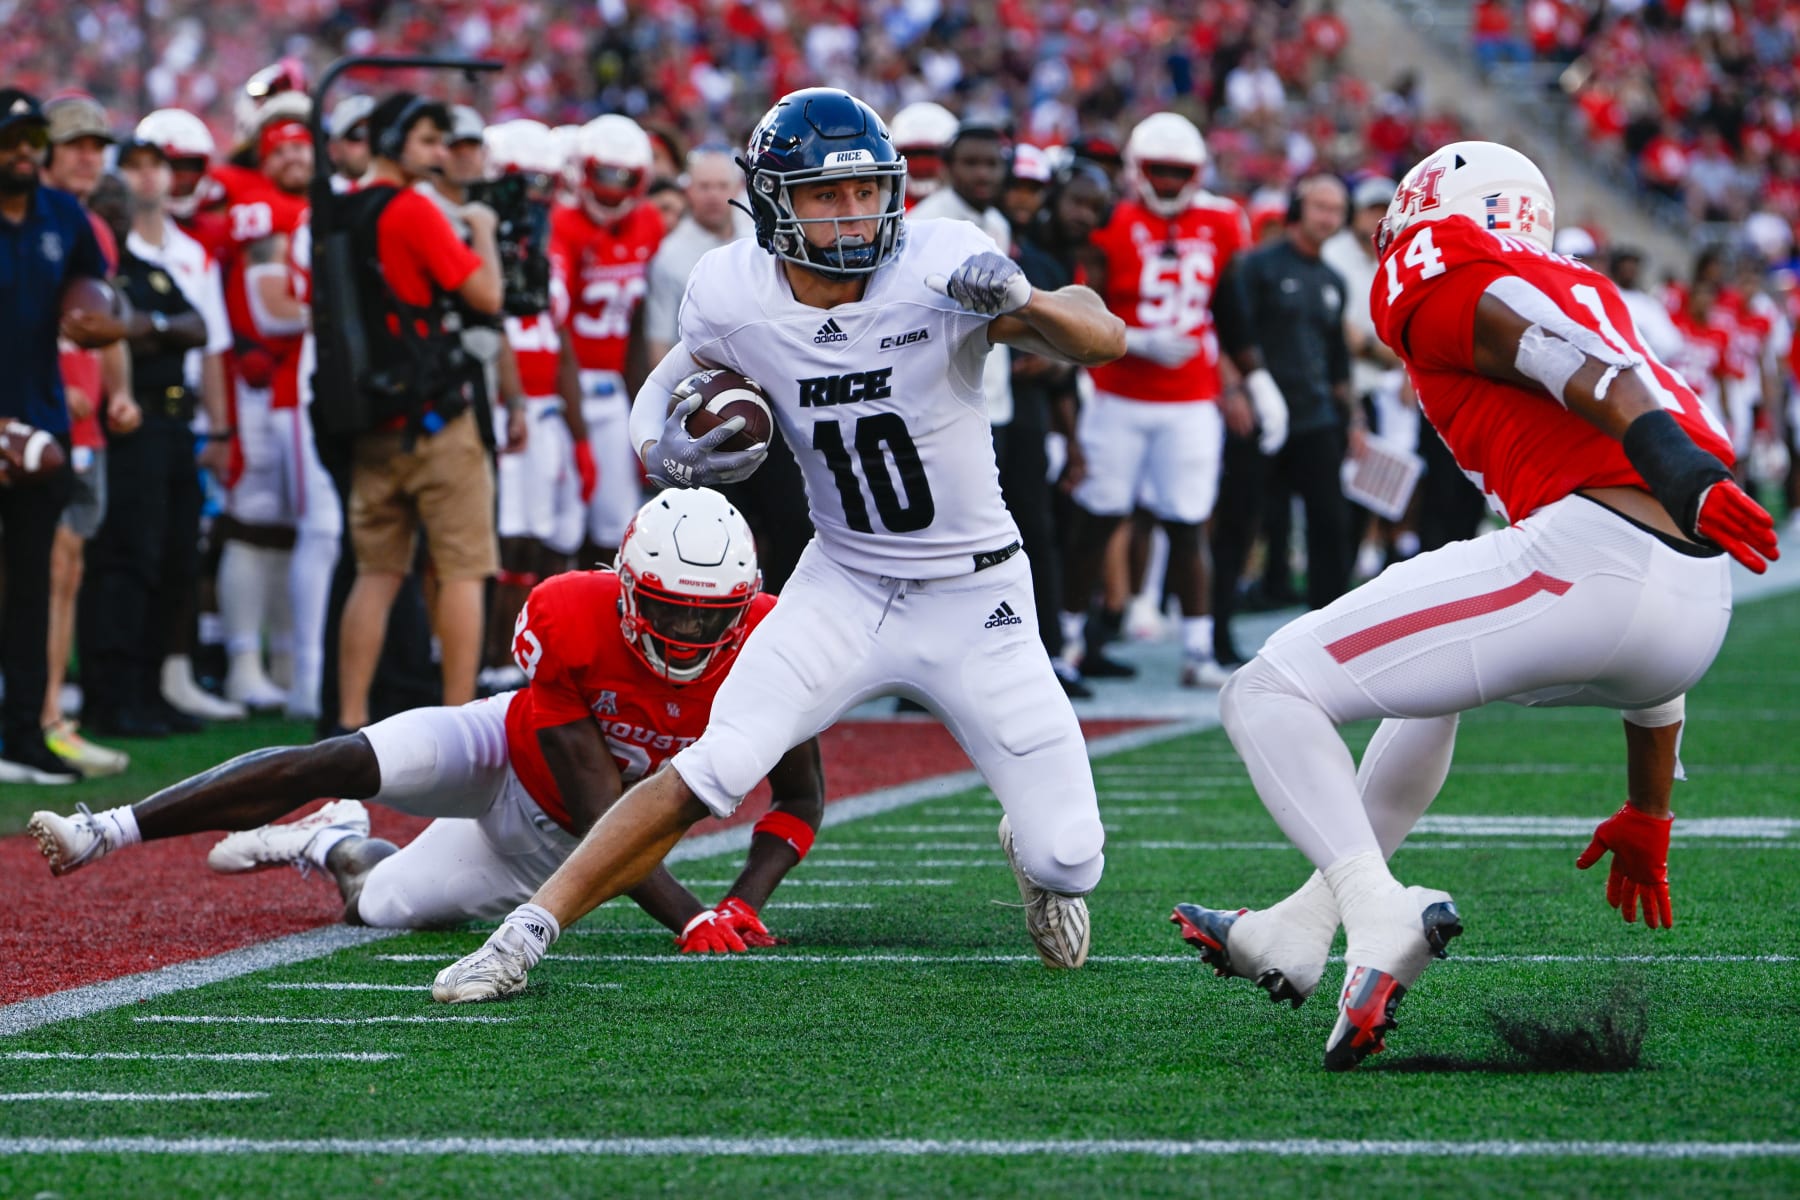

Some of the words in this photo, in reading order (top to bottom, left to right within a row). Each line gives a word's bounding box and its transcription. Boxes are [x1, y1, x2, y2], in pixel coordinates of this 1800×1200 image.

[837, 152, 862, 162] RICE
[1385, 227, 1446, 306] 14
[1137, 251, 1214, 331] 56
[814, 333, 848, 343] adidas
[796, 367, 893, 407] RICE
[813, 412, 934, 534] 10
[679, 579, 716, 588] HOUSTON
[984, 616, 1022, 629] adidas
